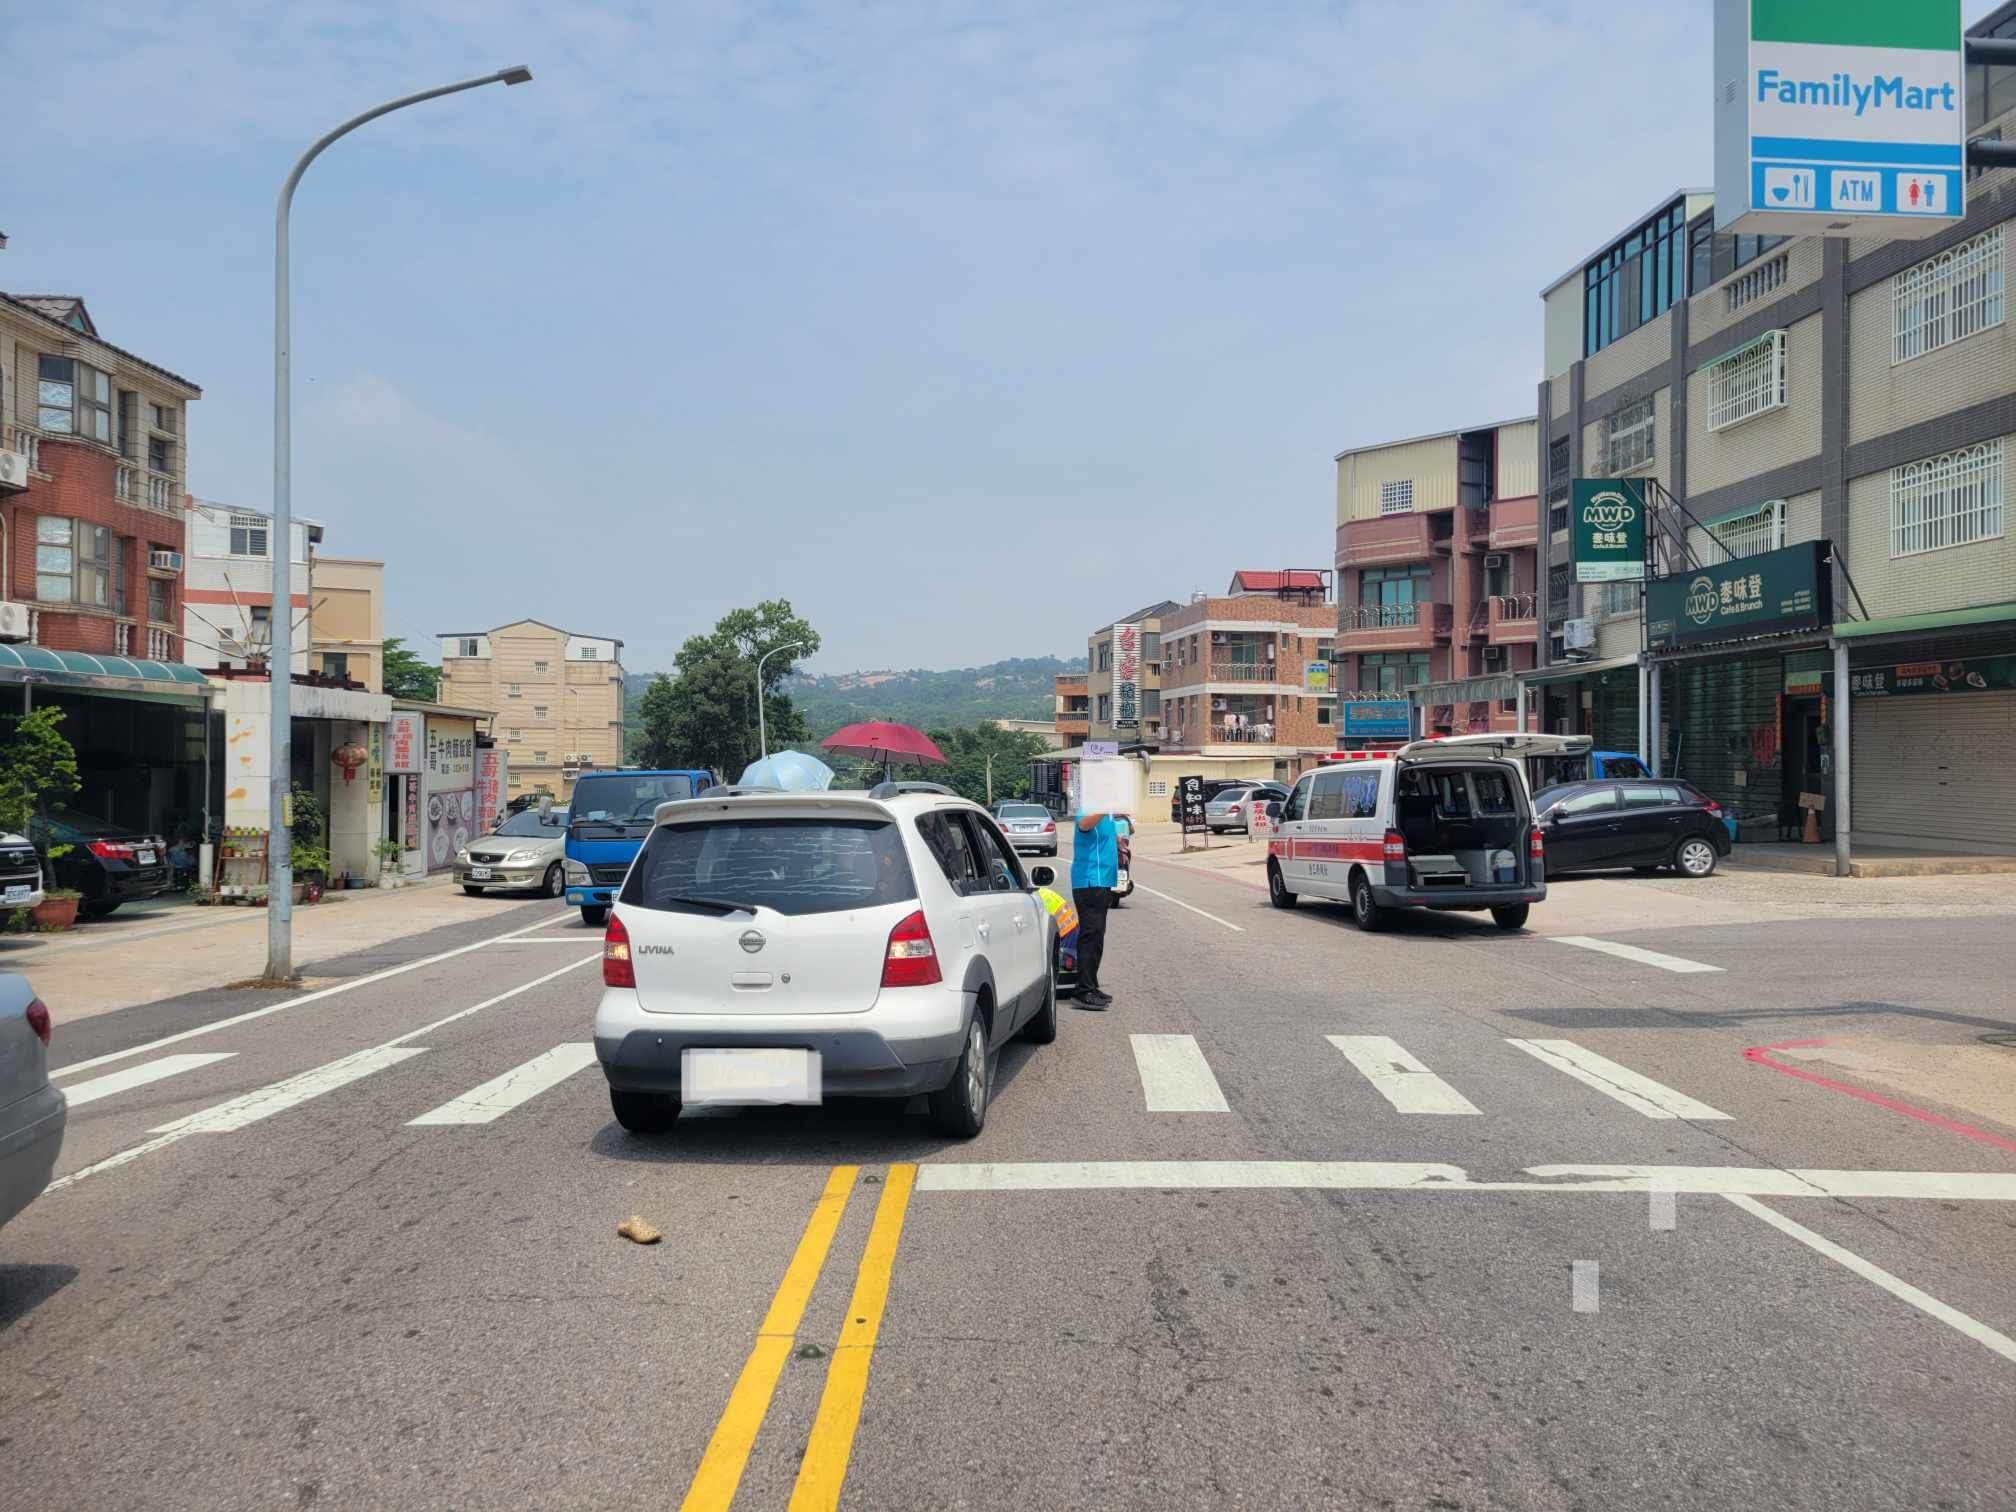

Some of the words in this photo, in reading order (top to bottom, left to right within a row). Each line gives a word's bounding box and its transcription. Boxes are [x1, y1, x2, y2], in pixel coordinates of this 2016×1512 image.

[1757, 69, 1955, 116] FamilyMart
[1839, 179, 1873, 202] ATM
[1583, 506, 1635, 523] MWD
[1685, 591, 1719, 616] MWD
[638, 944, 675, 955] LIVINA
